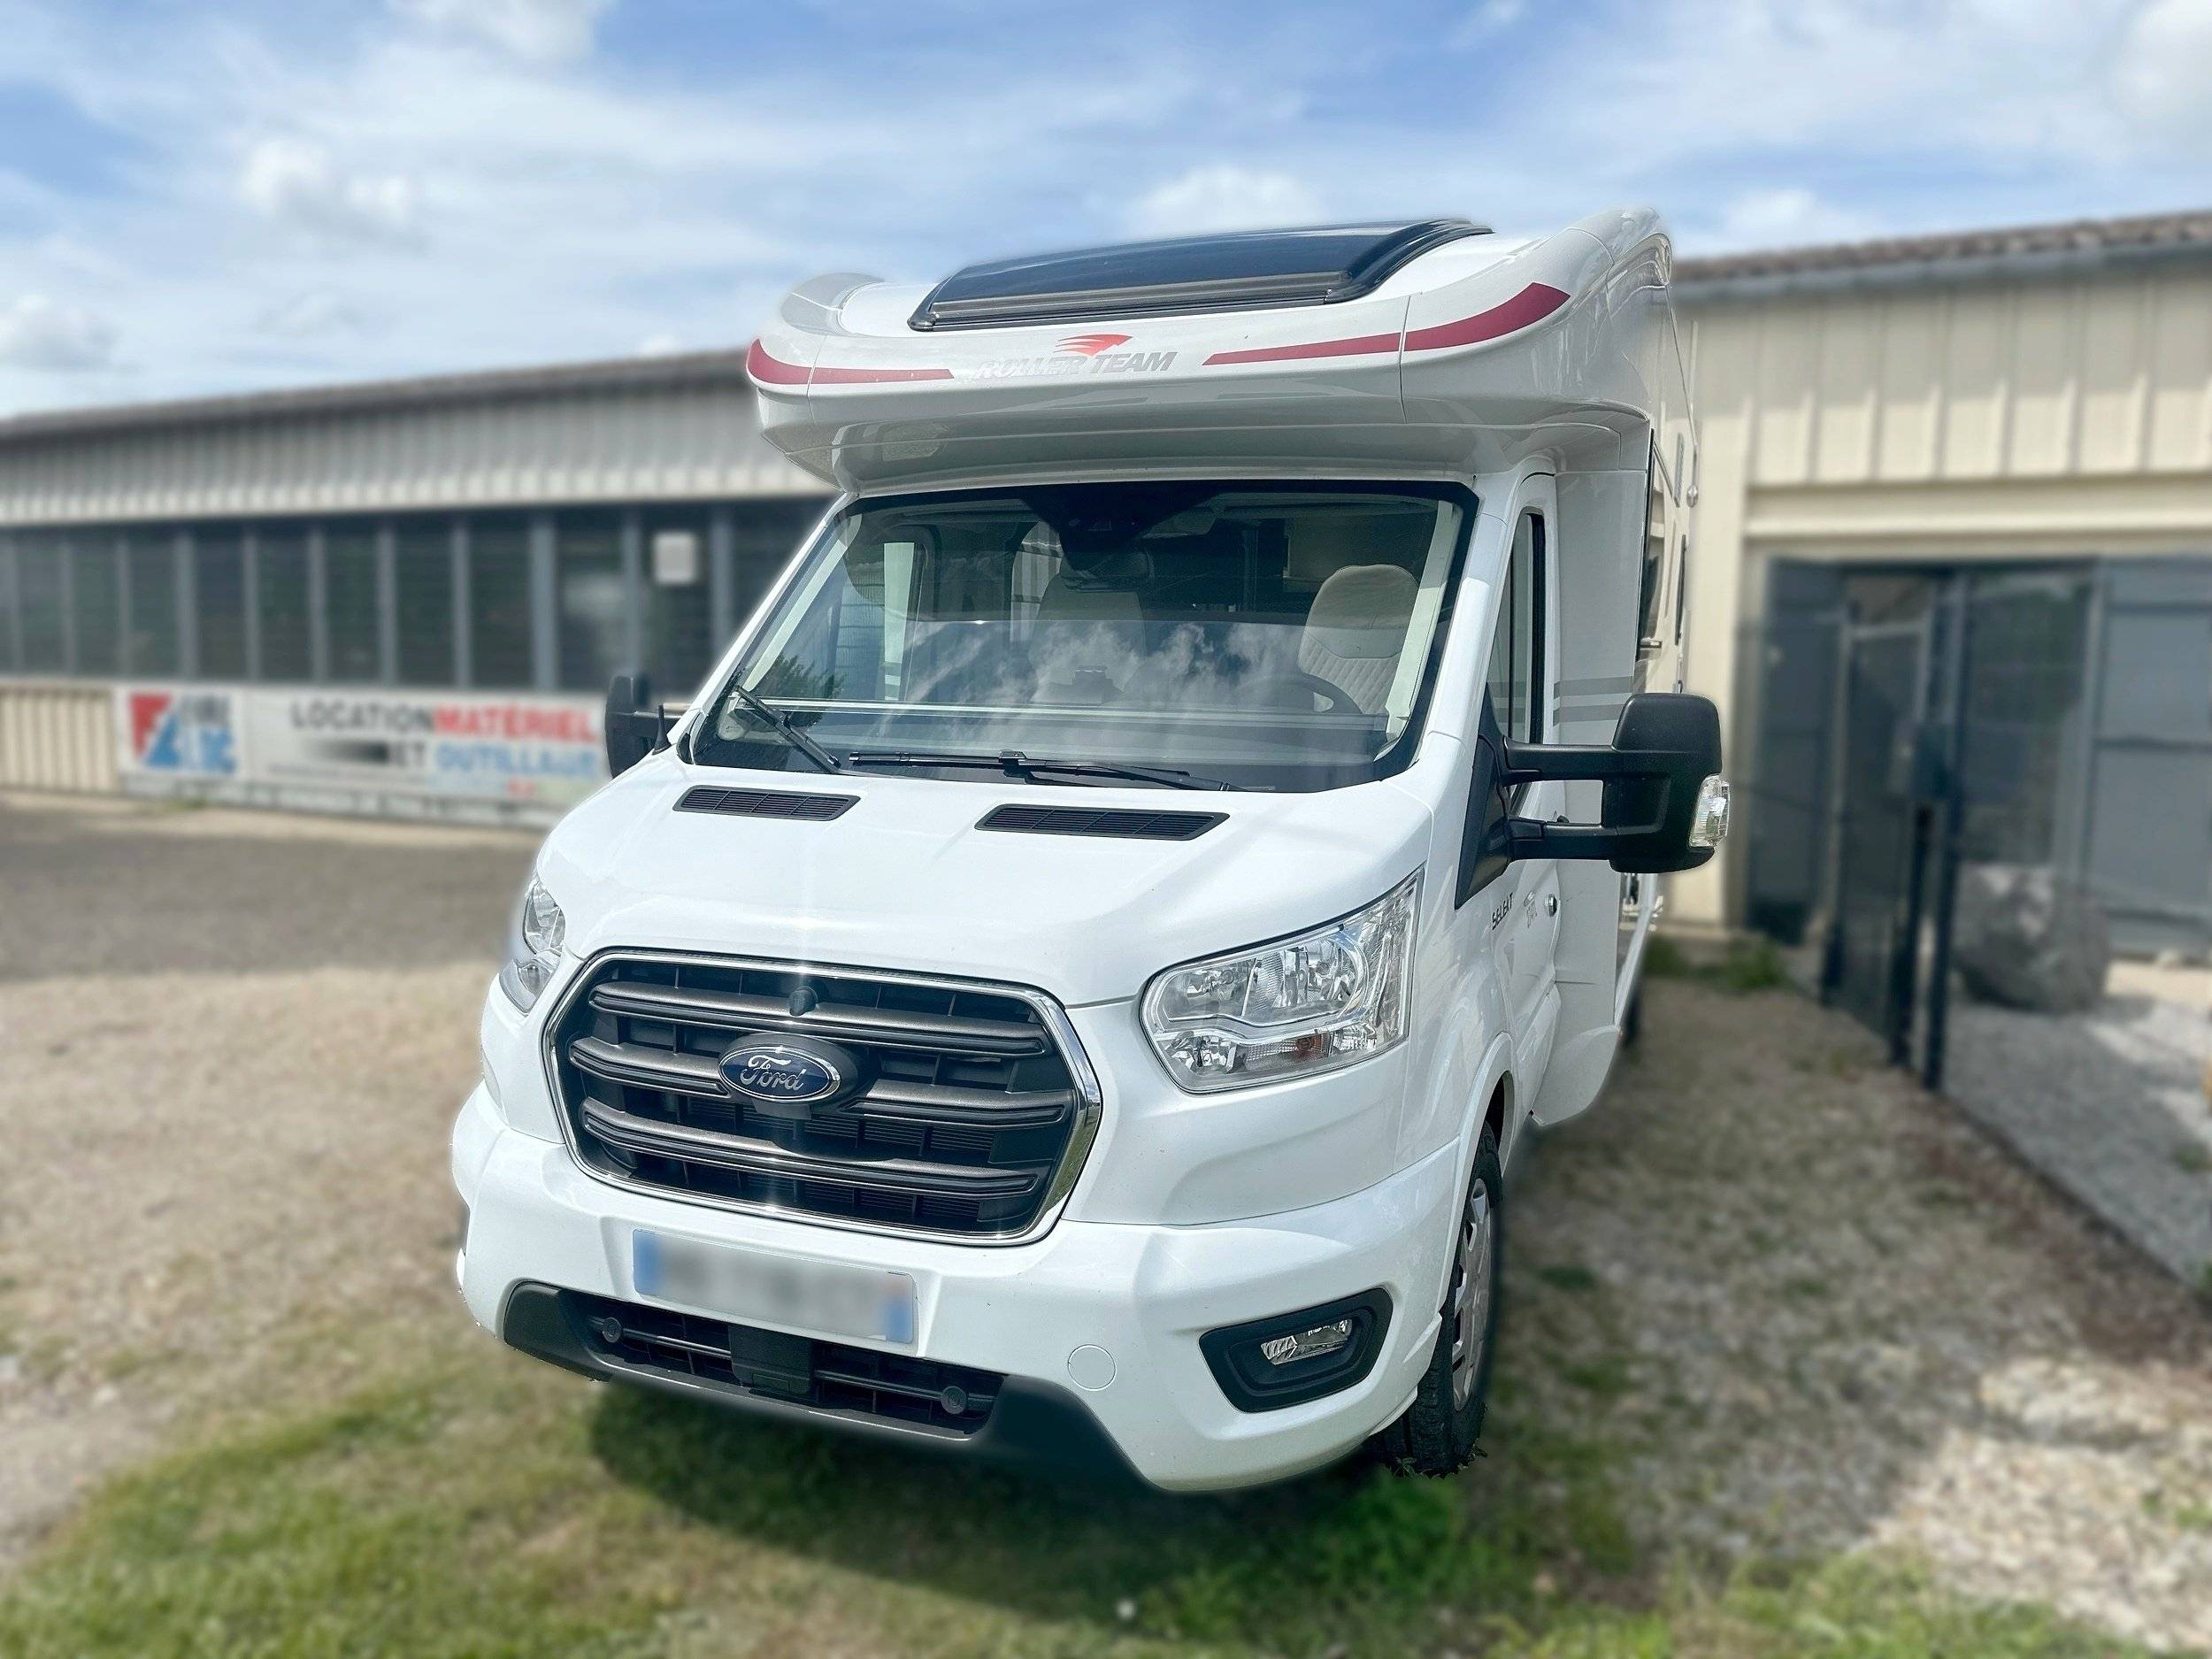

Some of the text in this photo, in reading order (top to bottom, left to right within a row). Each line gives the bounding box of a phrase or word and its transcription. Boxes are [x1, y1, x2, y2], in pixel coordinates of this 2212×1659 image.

[972, 351, 1178, 379] ROLLER TEAM
[290, 700, 596, 743] LOCATION MATÉRIEL
[740, 1055, 807, 1091] Ford
